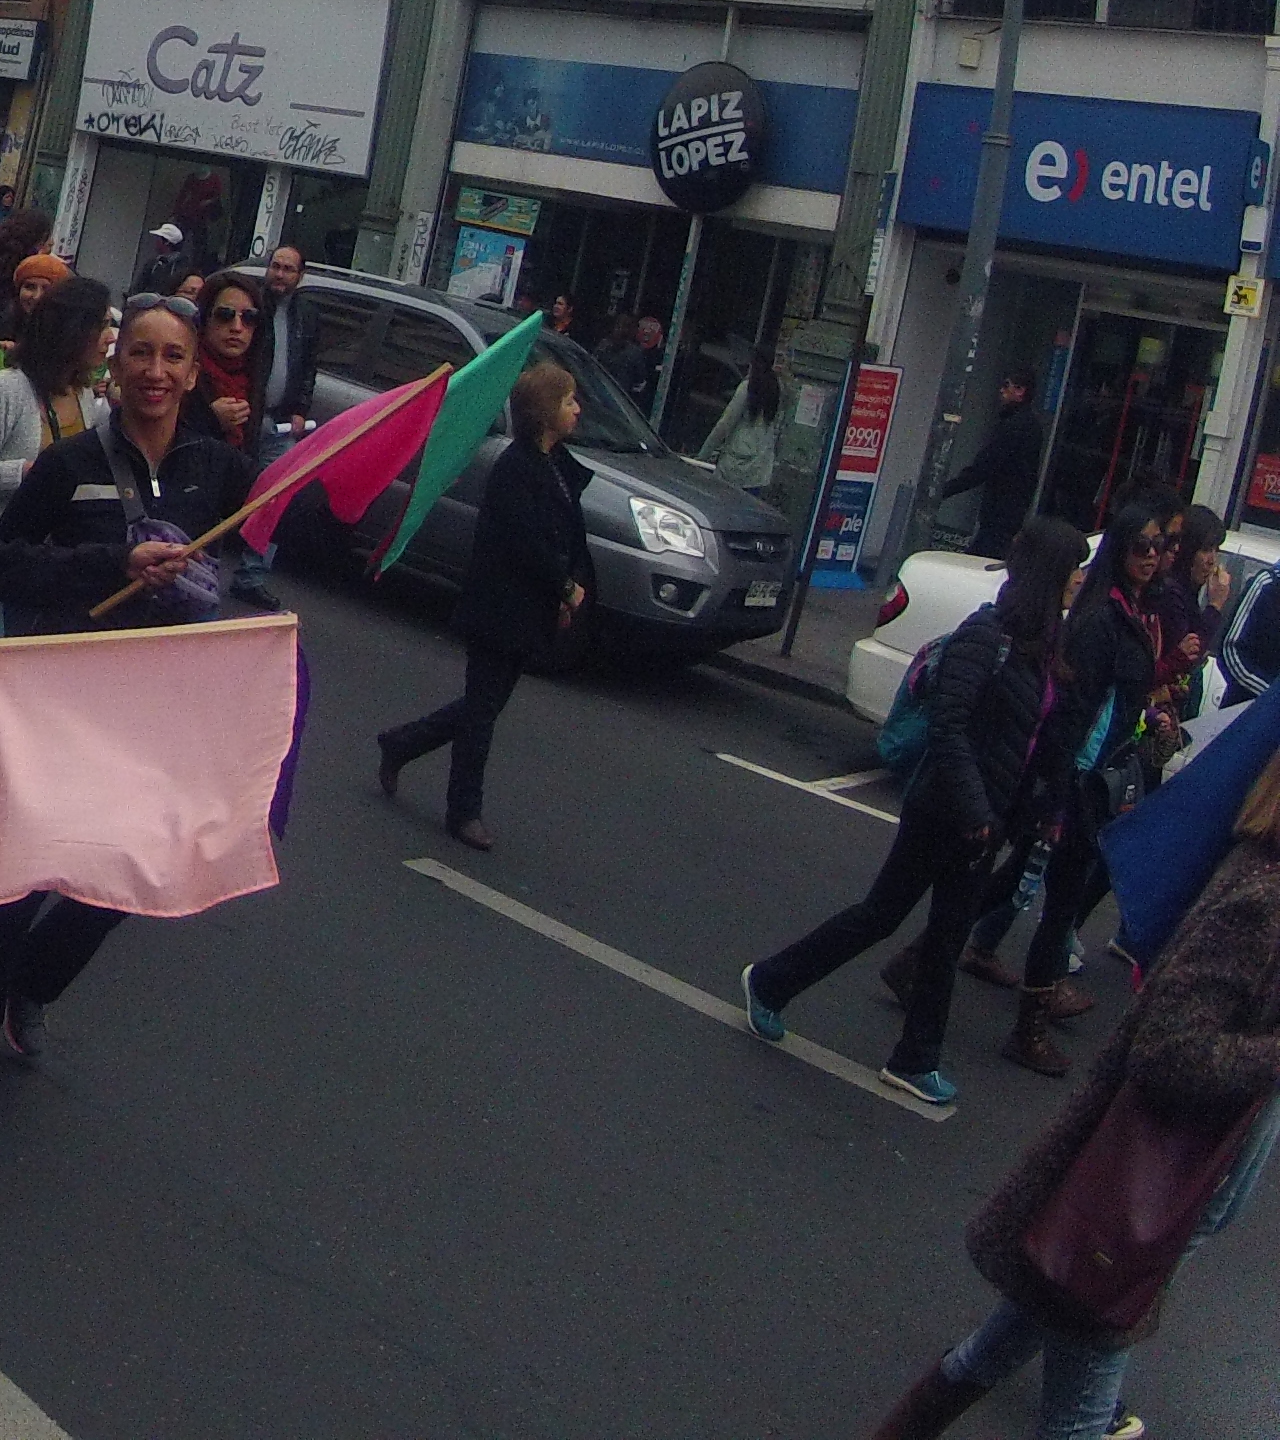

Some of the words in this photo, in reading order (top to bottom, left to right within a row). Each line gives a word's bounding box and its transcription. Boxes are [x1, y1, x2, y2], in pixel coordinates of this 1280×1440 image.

[147, 24, 267, 107] Catz
[657, 90, 745, 138] LAPIZ
[658, 131, 749, 180] LOPEZ
[1101, 160, 1212, 212] entel
